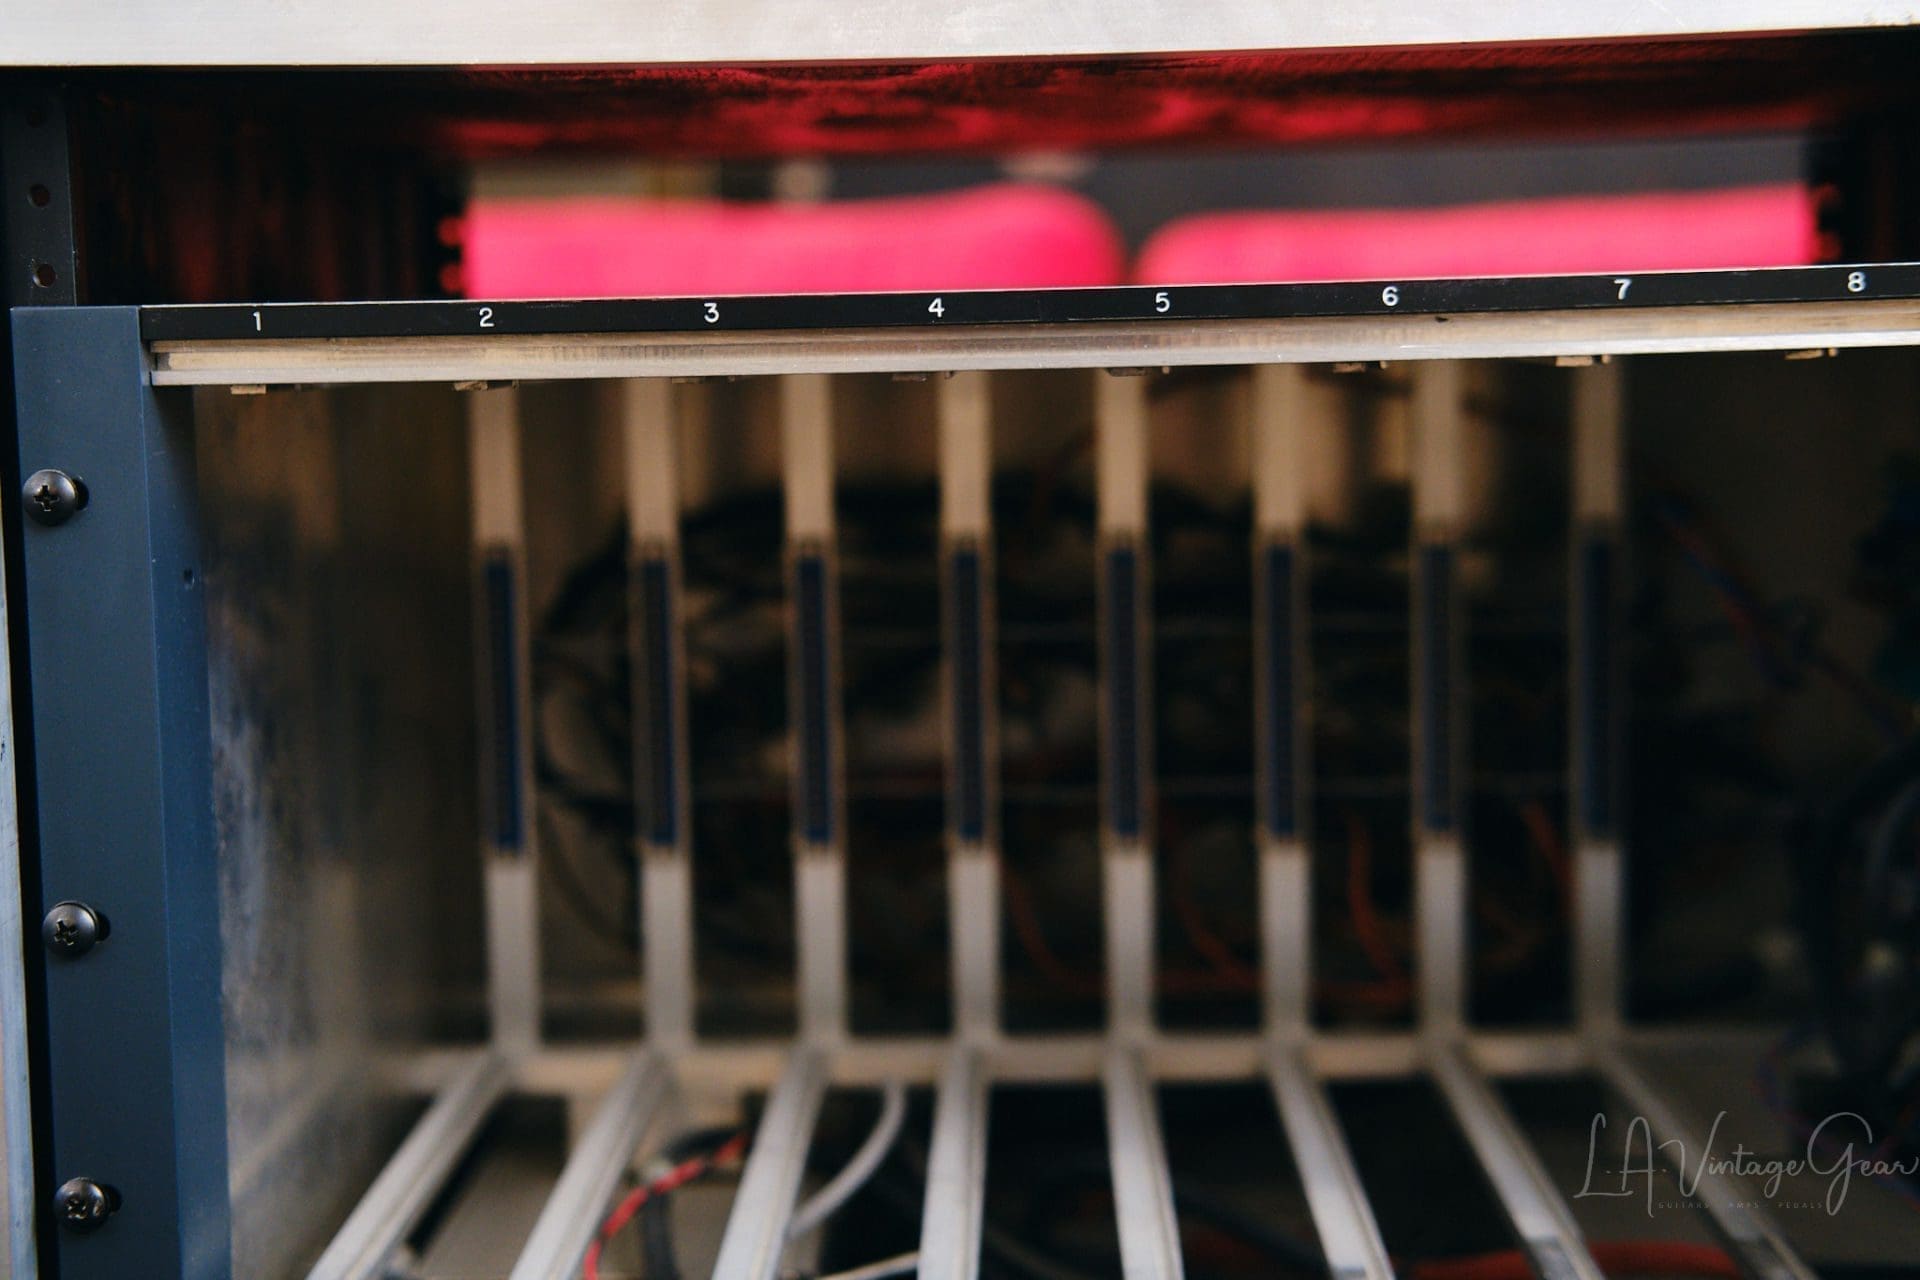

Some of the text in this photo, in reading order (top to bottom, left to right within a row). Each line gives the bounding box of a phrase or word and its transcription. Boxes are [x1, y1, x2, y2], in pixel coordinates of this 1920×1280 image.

[252, 271, 1867, 332] 1 2 3 4 5 6 7 8
